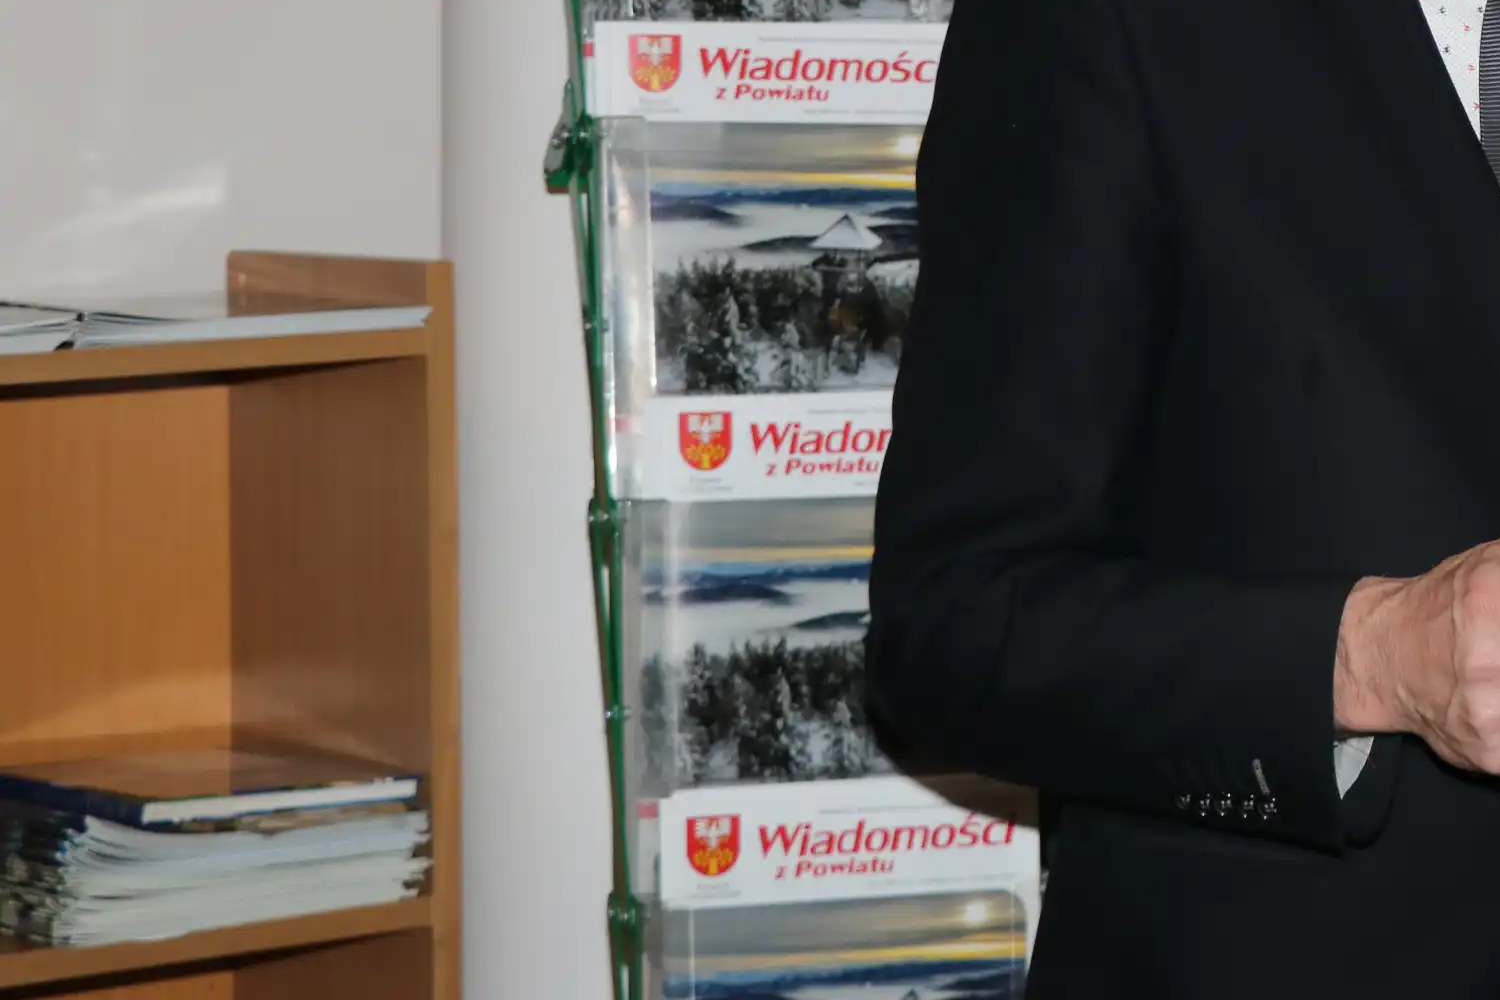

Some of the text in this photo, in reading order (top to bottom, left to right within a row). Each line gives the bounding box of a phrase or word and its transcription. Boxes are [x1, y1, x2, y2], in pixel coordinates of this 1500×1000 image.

[699, 46, 937, 84] Wiadomośc
[715, 83, 830, 102] z Powiatu
[765, 457, 879, 477] z Powiatu
[757, 811, 1017, 858] Wiadomości
[775, 858, 895, 880] z Powiatu
